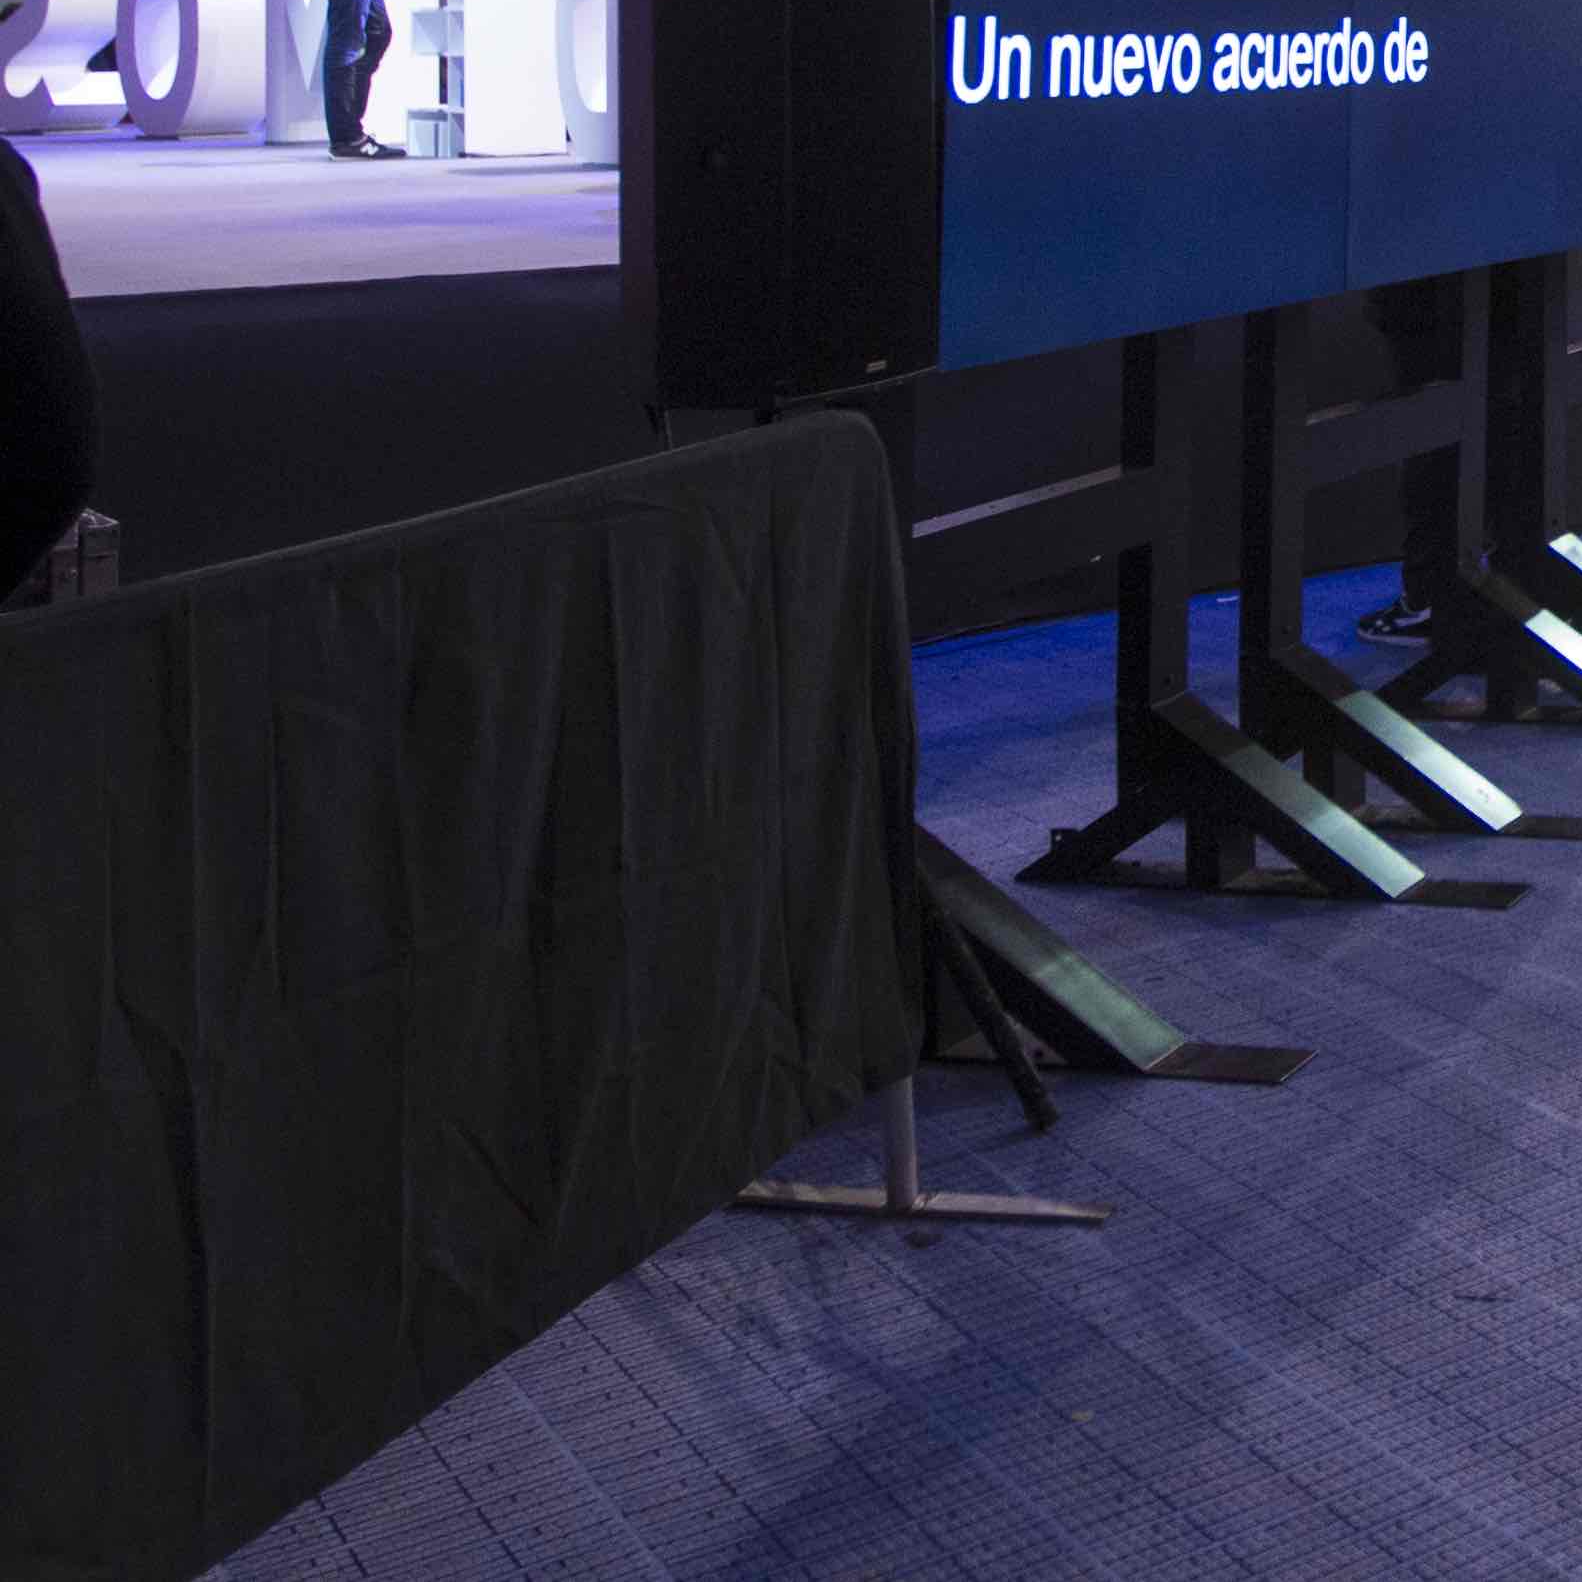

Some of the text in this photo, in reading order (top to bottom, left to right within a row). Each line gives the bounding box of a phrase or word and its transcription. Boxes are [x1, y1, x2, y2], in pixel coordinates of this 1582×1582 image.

[950, 14, 1429, 104] Un nuevo acuerdo de
